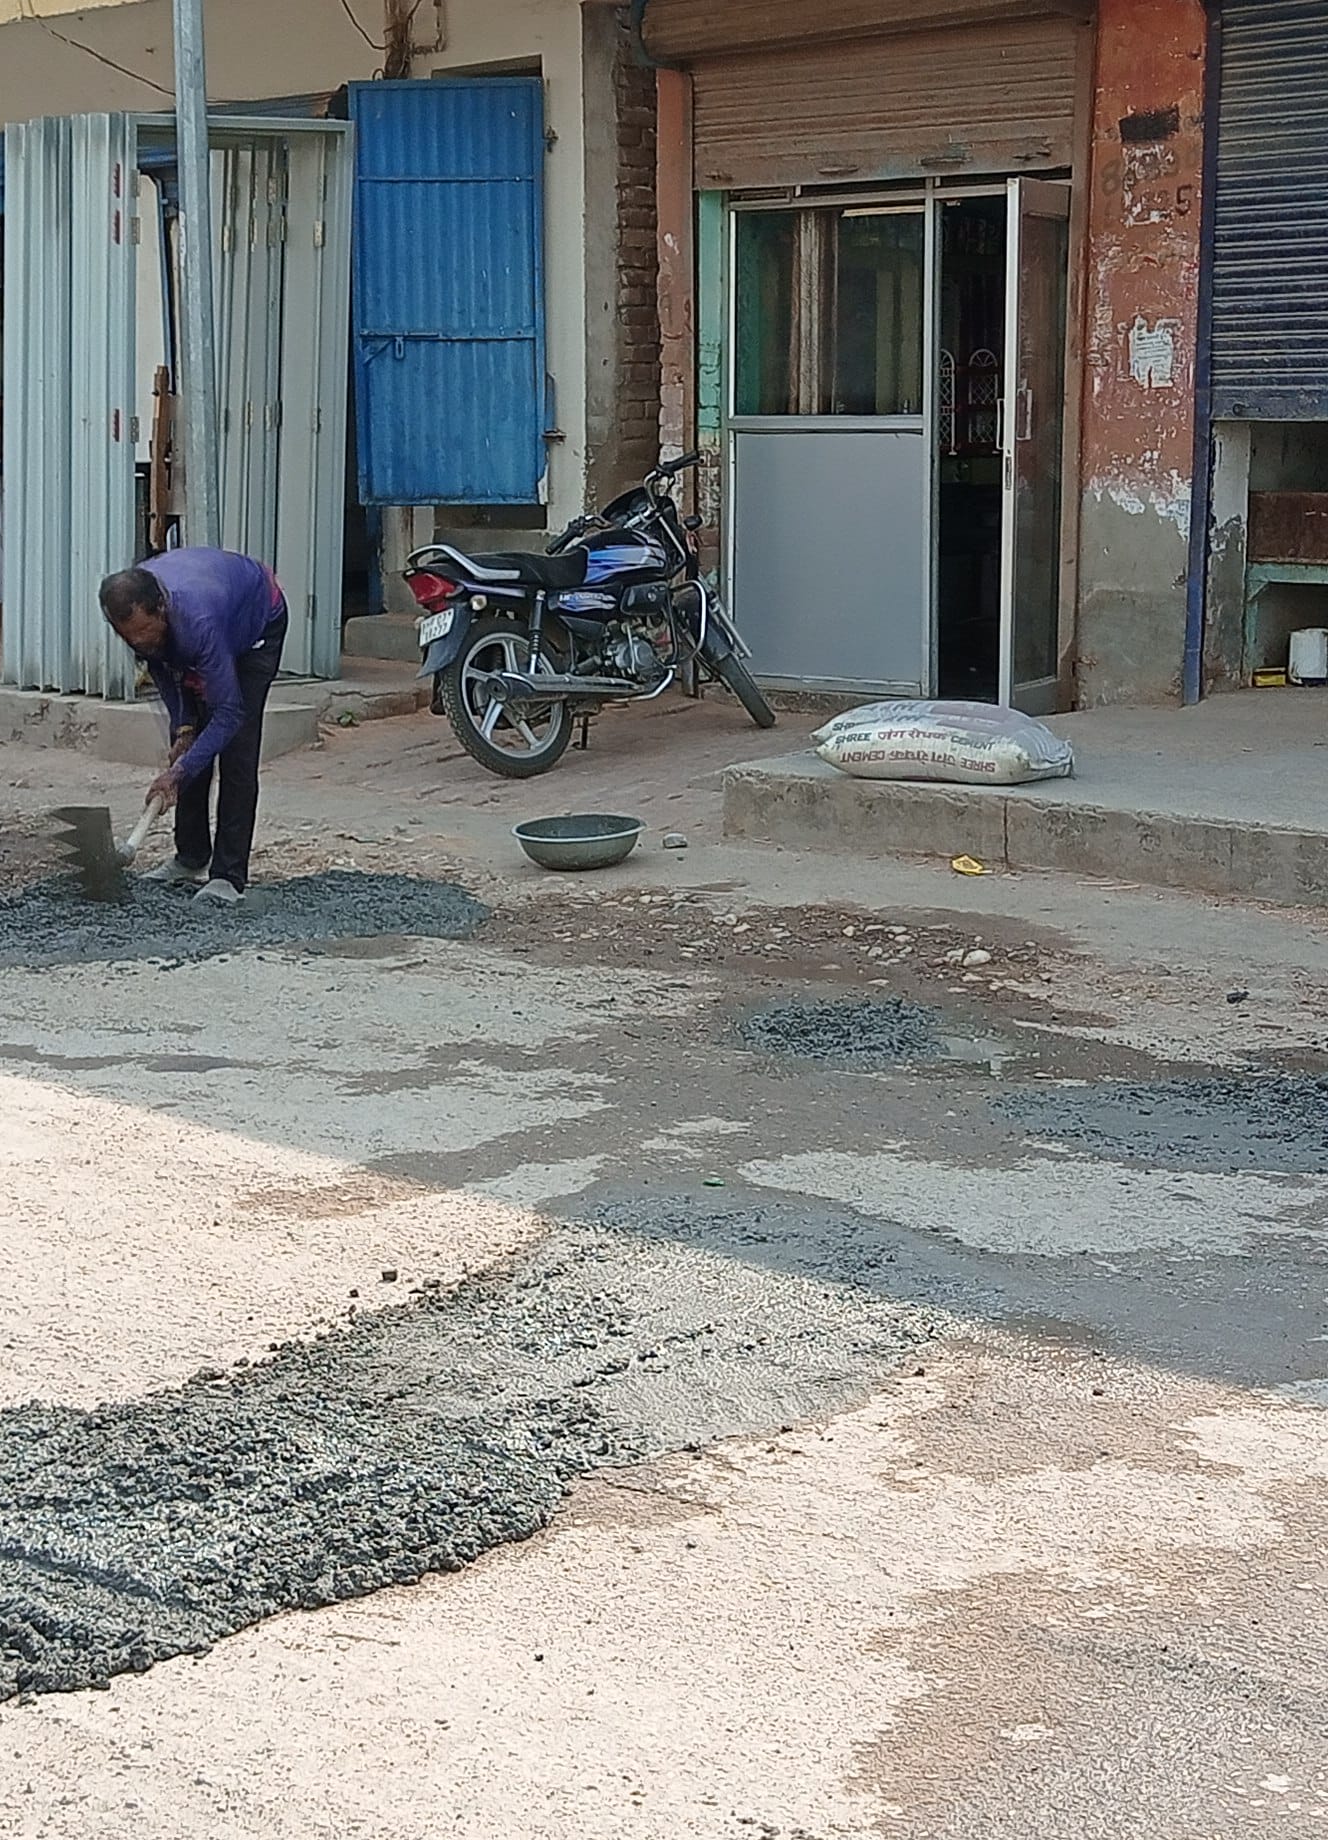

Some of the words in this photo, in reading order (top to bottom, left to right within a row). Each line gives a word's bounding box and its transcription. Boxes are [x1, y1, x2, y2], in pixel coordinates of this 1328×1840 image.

[835, 732, 872, 745] SHREE
[840, 750, 886, 764] CEMENT
[960, 757, 996, 773] SHREE
